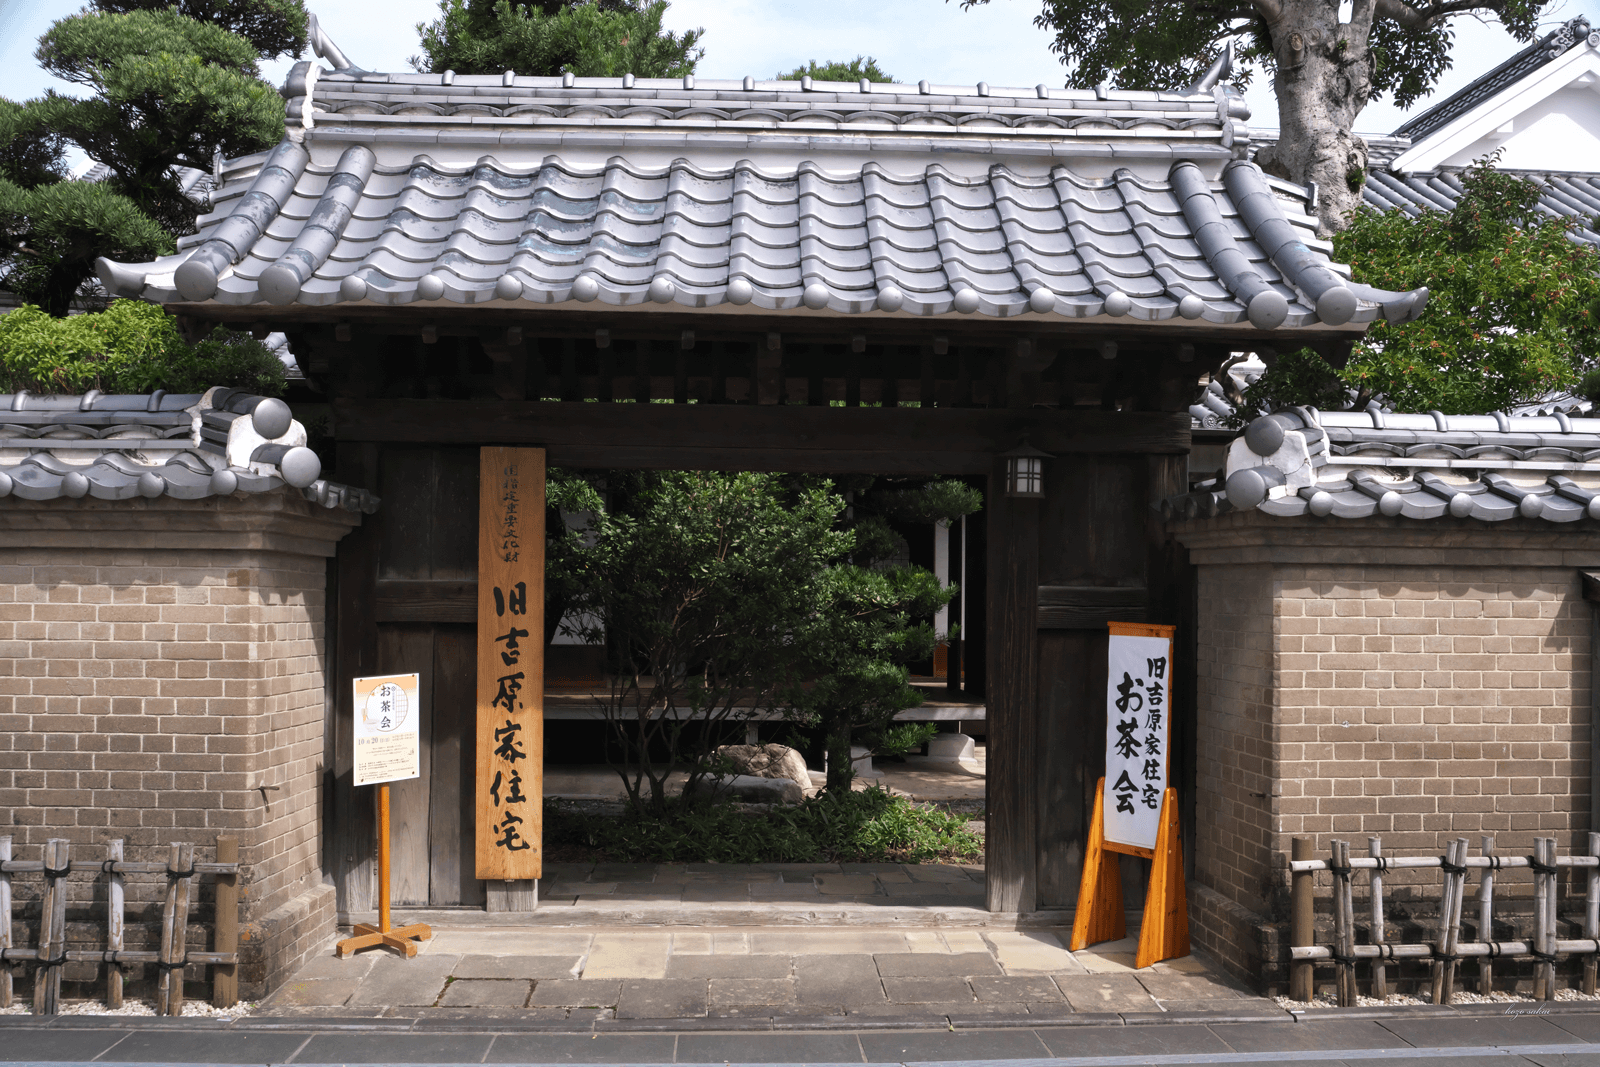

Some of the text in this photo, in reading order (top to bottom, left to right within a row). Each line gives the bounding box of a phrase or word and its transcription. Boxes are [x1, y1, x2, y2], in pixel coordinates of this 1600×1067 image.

[380, 685, 391, 729] お茶会
[491, 582, 531, 852] 旧吉原家住宅
[1112, 671, 1145, 815] お茶会
[1141, 656, 1167, 811] 旧吉原家住宅
